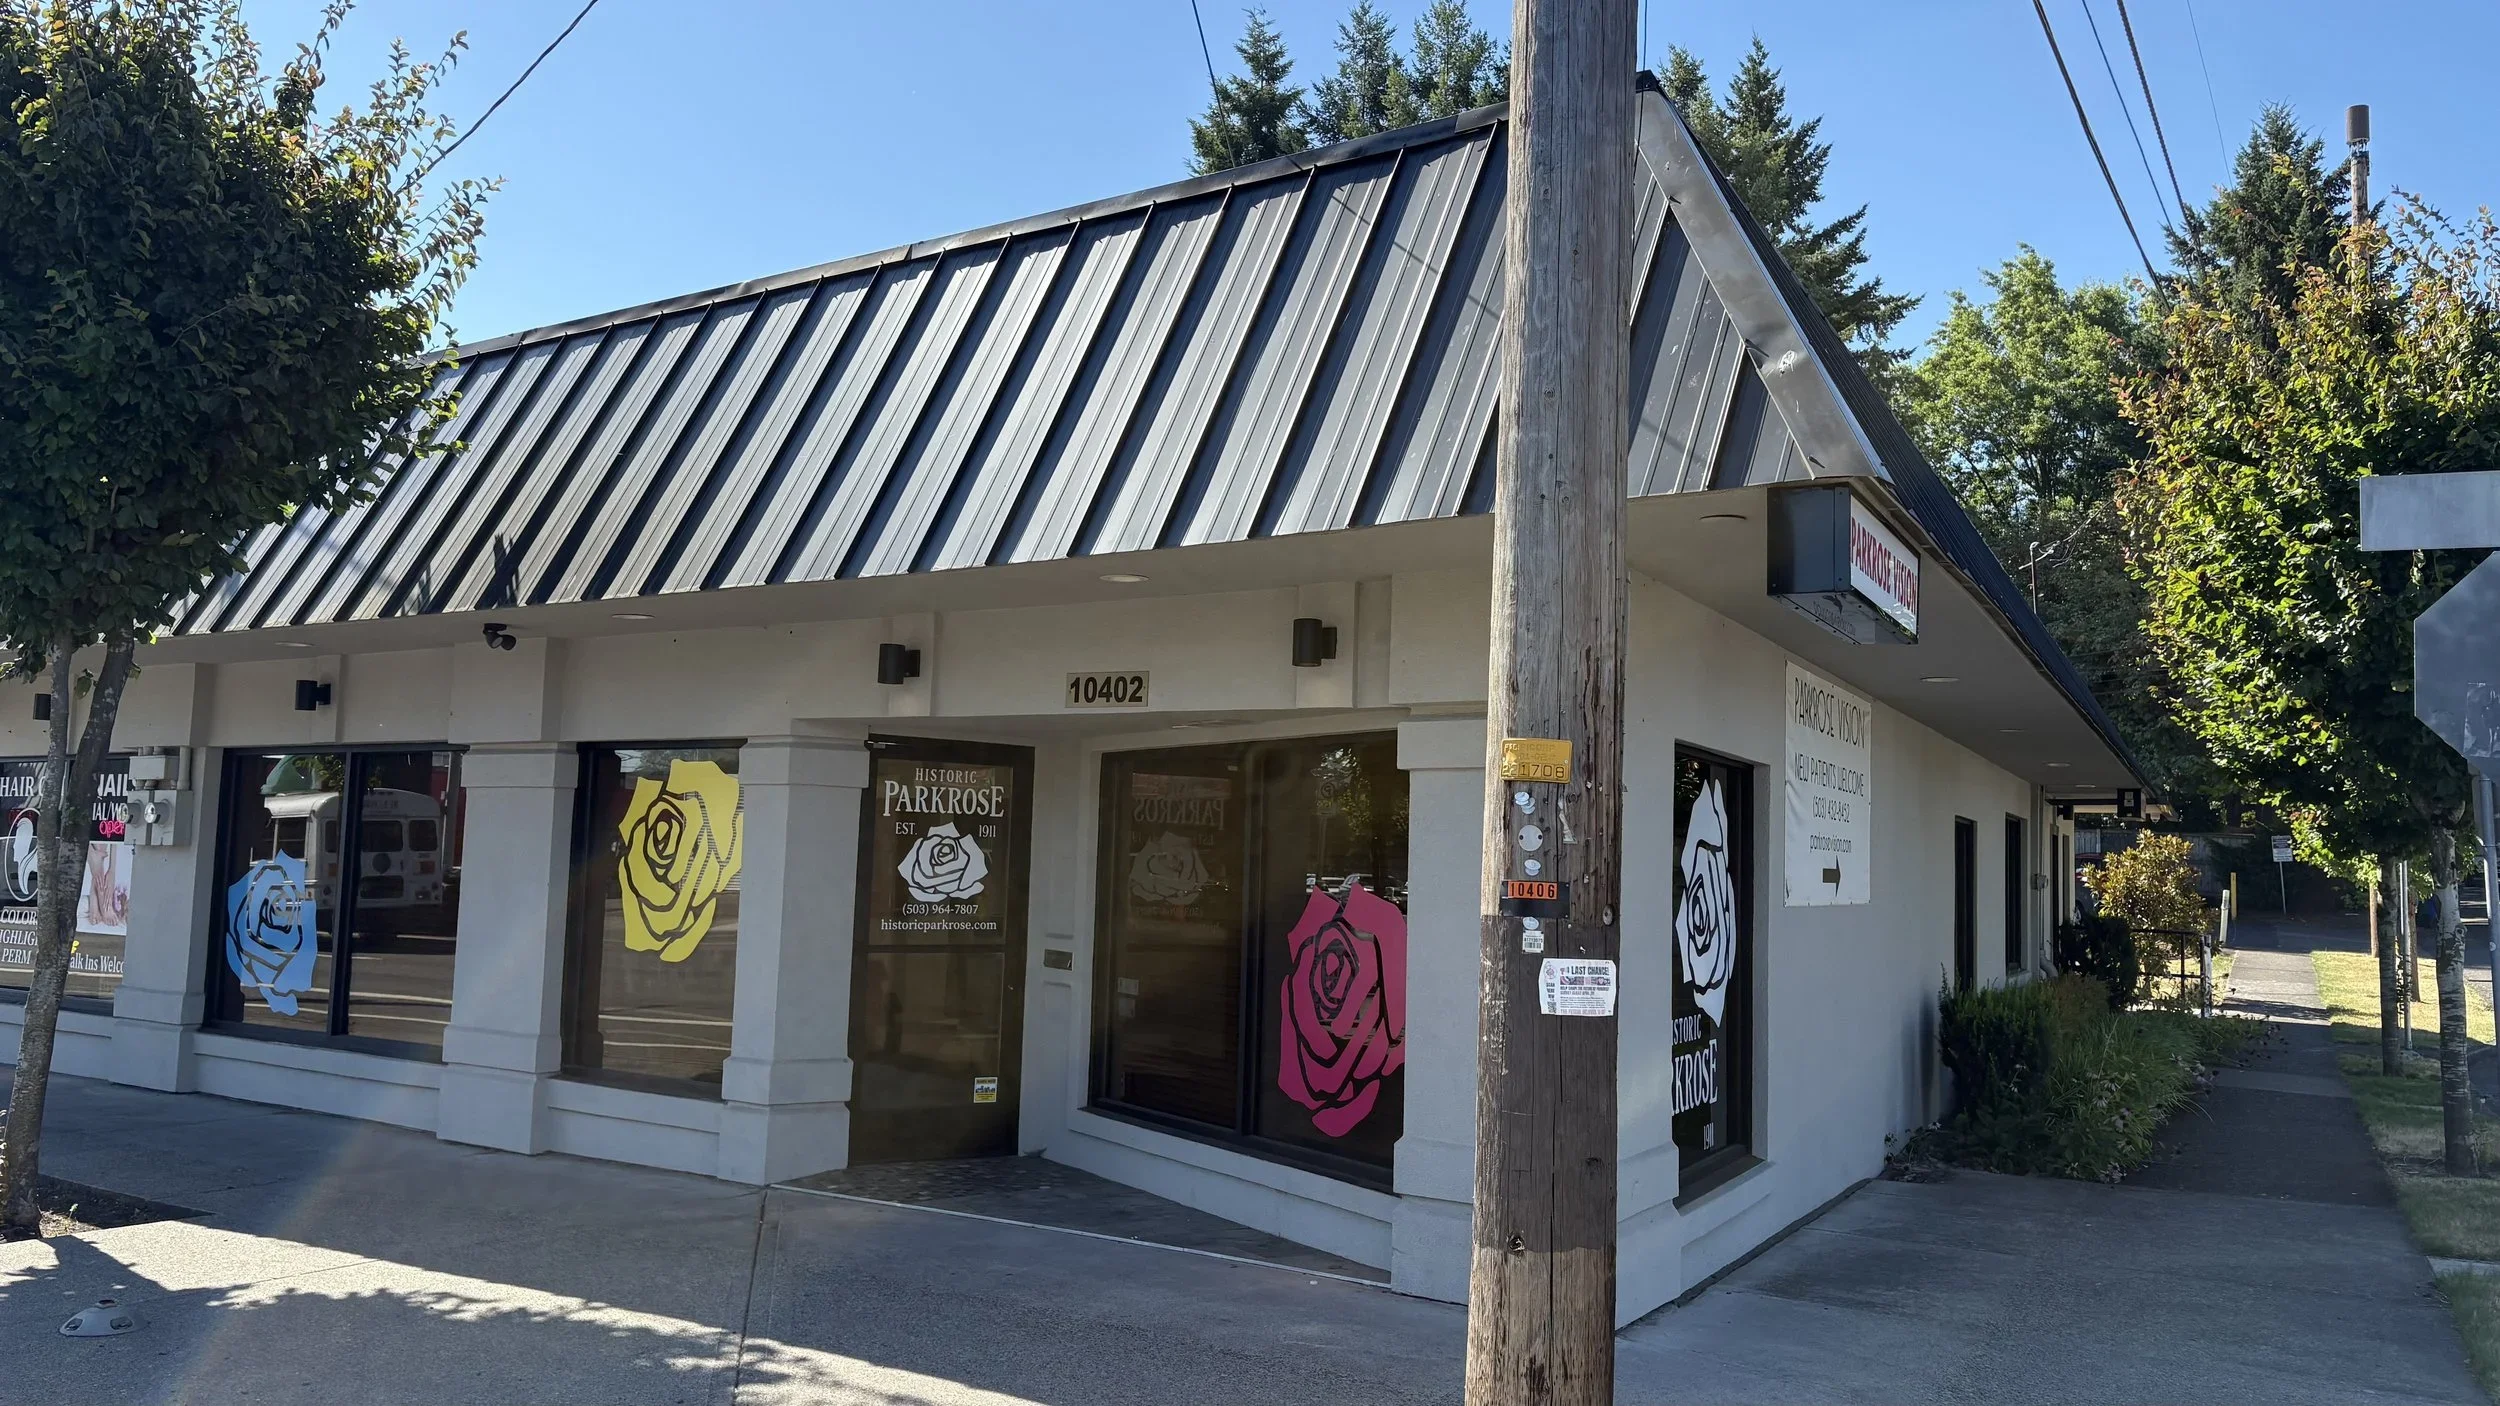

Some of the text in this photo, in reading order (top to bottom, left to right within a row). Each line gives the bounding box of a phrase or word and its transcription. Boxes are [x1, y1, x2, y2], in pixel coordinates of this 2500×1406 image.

[1851, 516, 1918, 615] PARKROSE VISION
[1070, 676, 1144, 703] 10402
[1794, 677, 1865, 748] PARKROSE VISION
[915, 767, 977, 784] HISTORIC
[1795, 752, 1864, 797] NEW PATIENTS WELCOME
[0, 776, 35, 797] HAIR
[882, 780, 1005, 818] PARKROSE
[895, 821, 997, 838] EST. 1911
[1809, 832, 1852, 853] parkrosevision.com
[1510, 883, 1555, 898] 10406
[902, 903, 979, 916] (503) 964-7807
[881, 919, 997, 933] historicparkrose.com
[2, 948, 32, 965] PERM
[69, 952, 84, 969] alk
[1571, 966, 1586, 975] LAST
[1703, 1122, 1714, 1151] 1911
